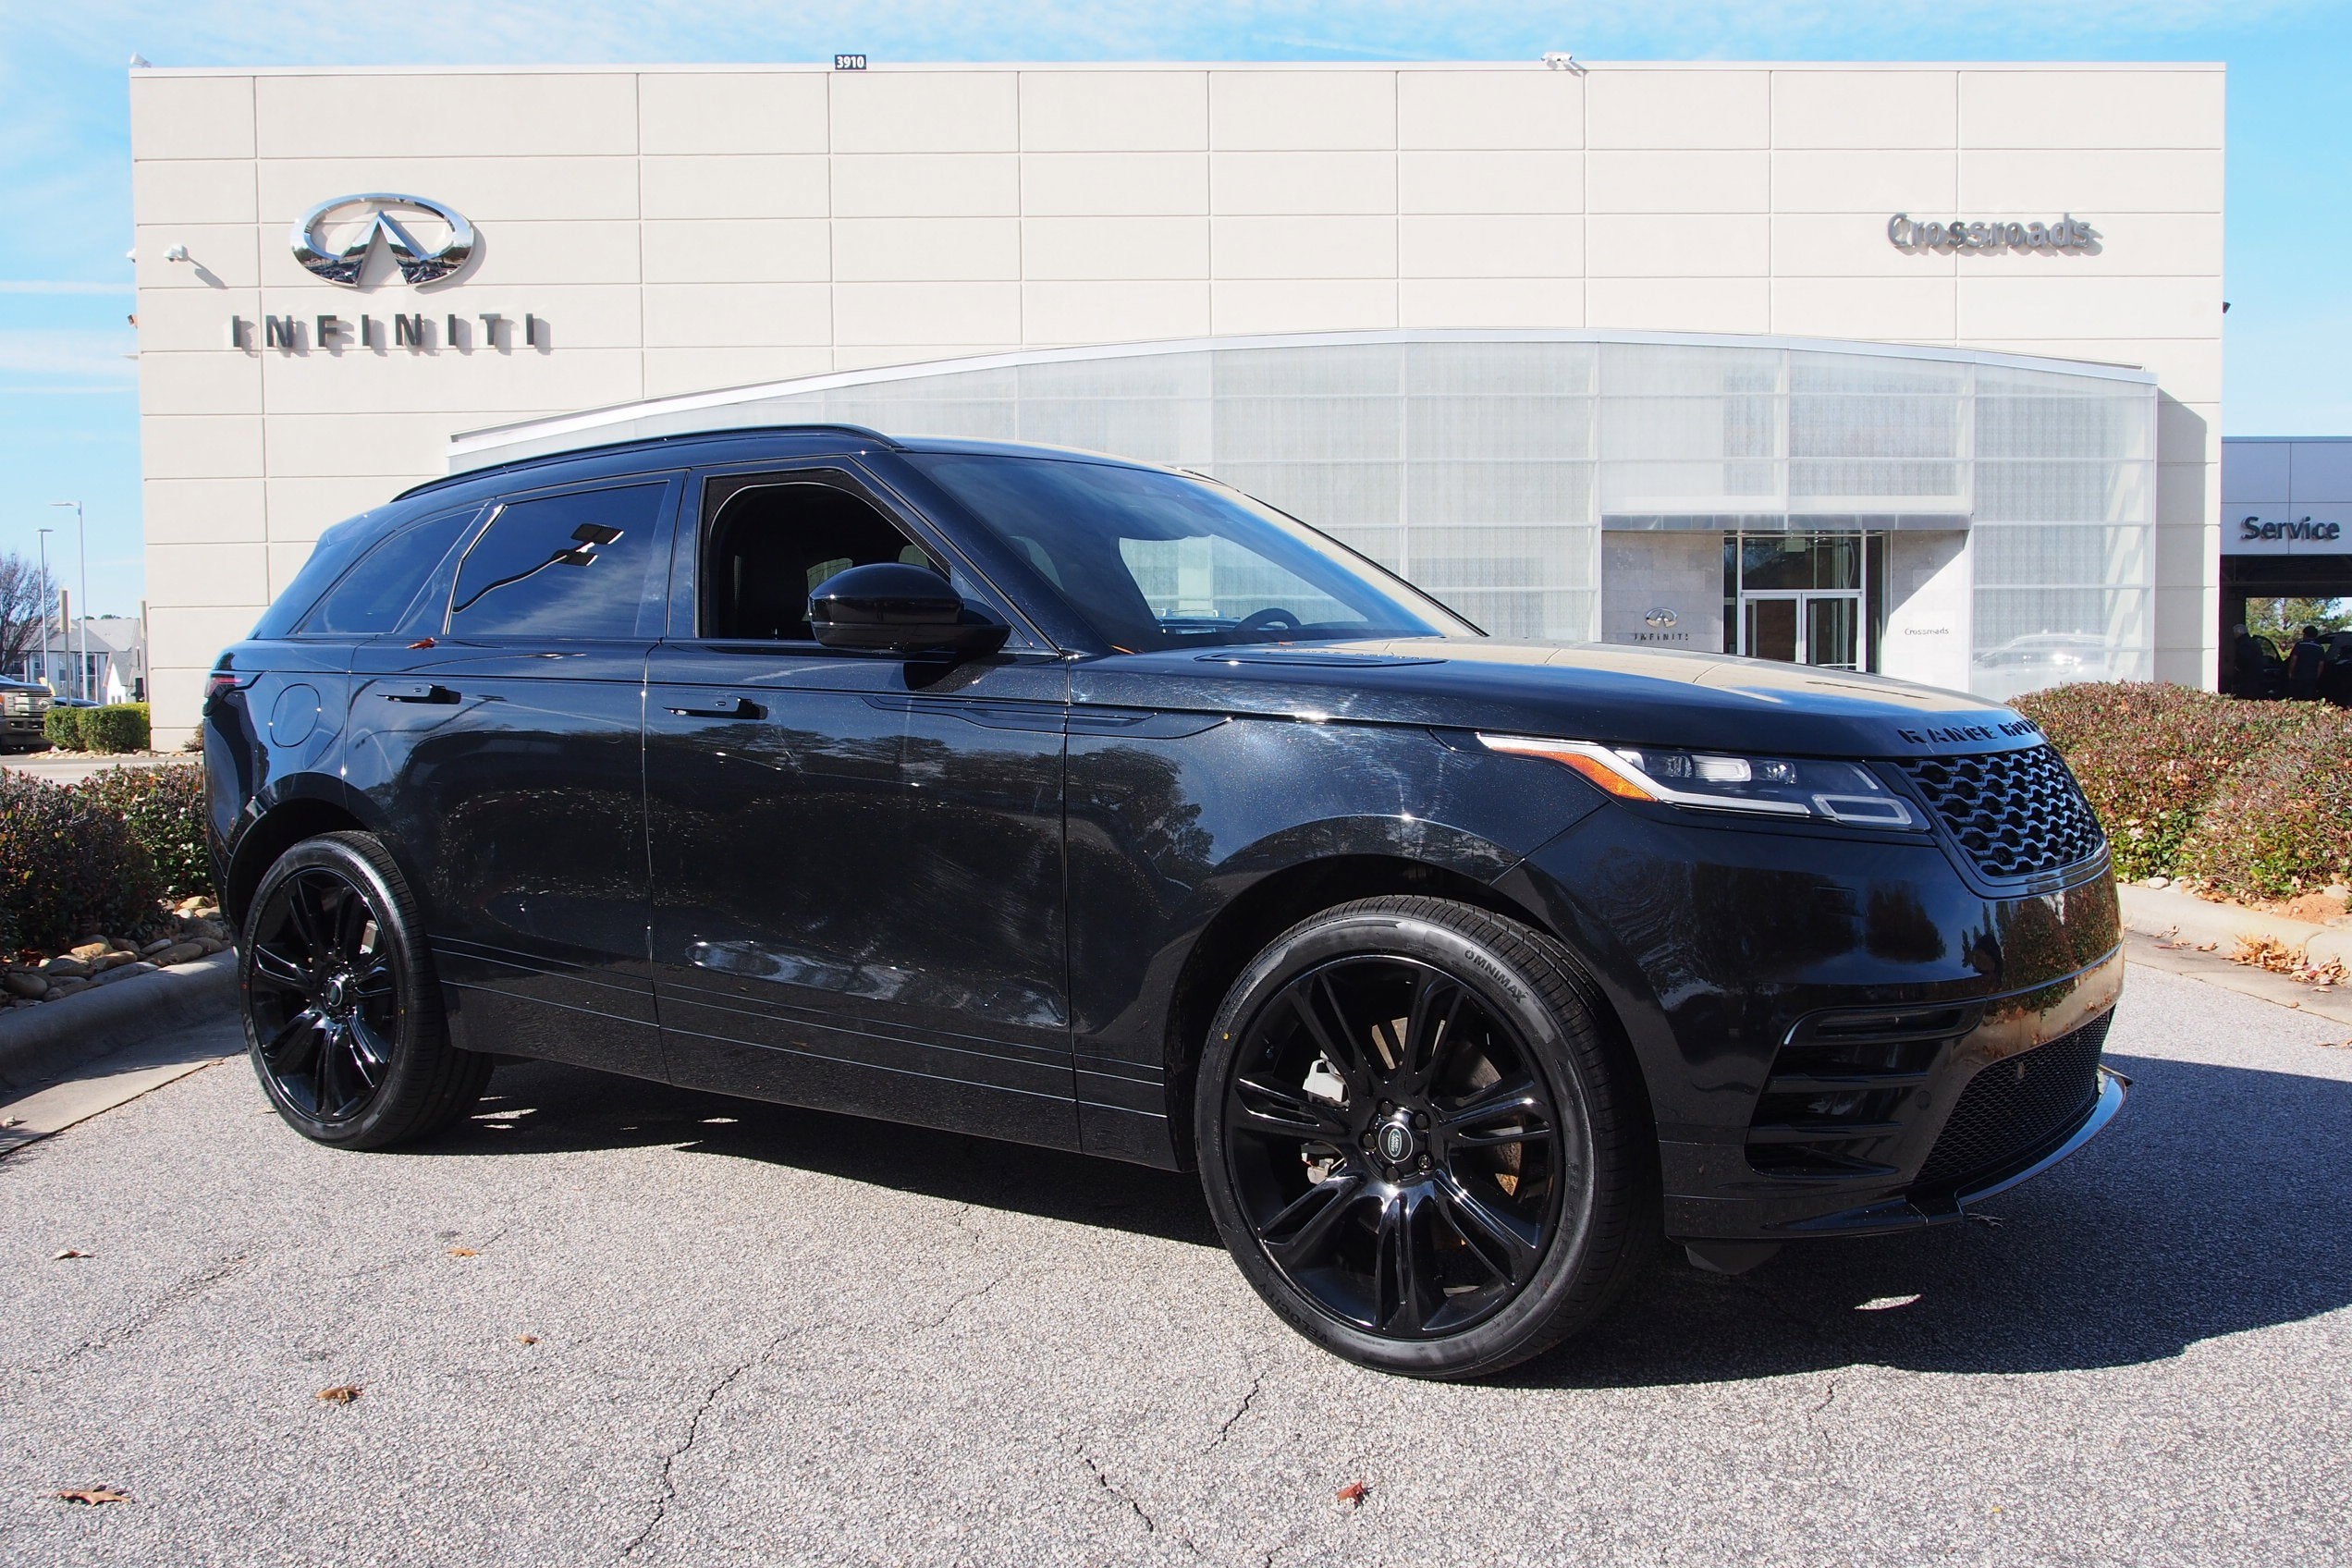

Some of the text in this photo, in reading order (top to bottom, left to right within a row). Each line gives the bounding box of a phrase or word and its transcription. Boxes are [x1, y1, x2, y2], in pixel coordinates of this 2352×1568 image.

[837, 55, 864, 68] 3910
[1887, 212, 2091, 247] Crossroads
[231, 312, 534, 348] INFINITI
[2242, 516, 2340, 540] Service
[1634, 632, 1689, 641] INFINITI
[1905, 627, 1949, 636] Crossroads
[1897, 726, 1998, 743] RANGE
[1464, 947, 1527, 1004] OMNIMAX
